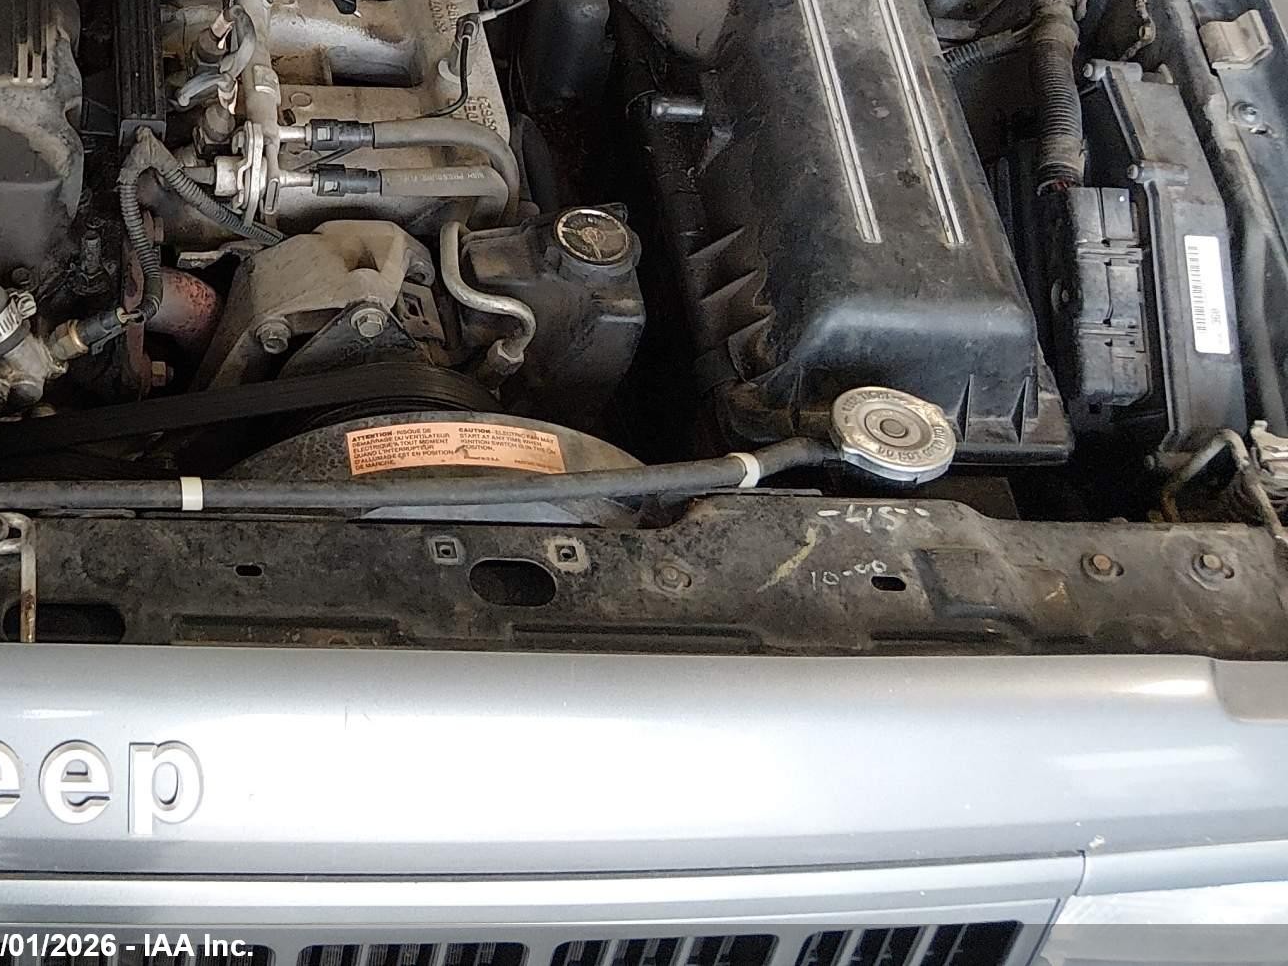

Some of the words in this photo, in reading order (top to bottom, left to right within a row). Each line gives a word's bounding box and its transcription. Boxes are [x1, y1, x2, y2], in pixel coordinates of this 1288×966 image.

[352, 431, 392, 442] ATTENTION
[523, 439, 542, 447] WHEN
[354, 451, 377, 459] QUAND
